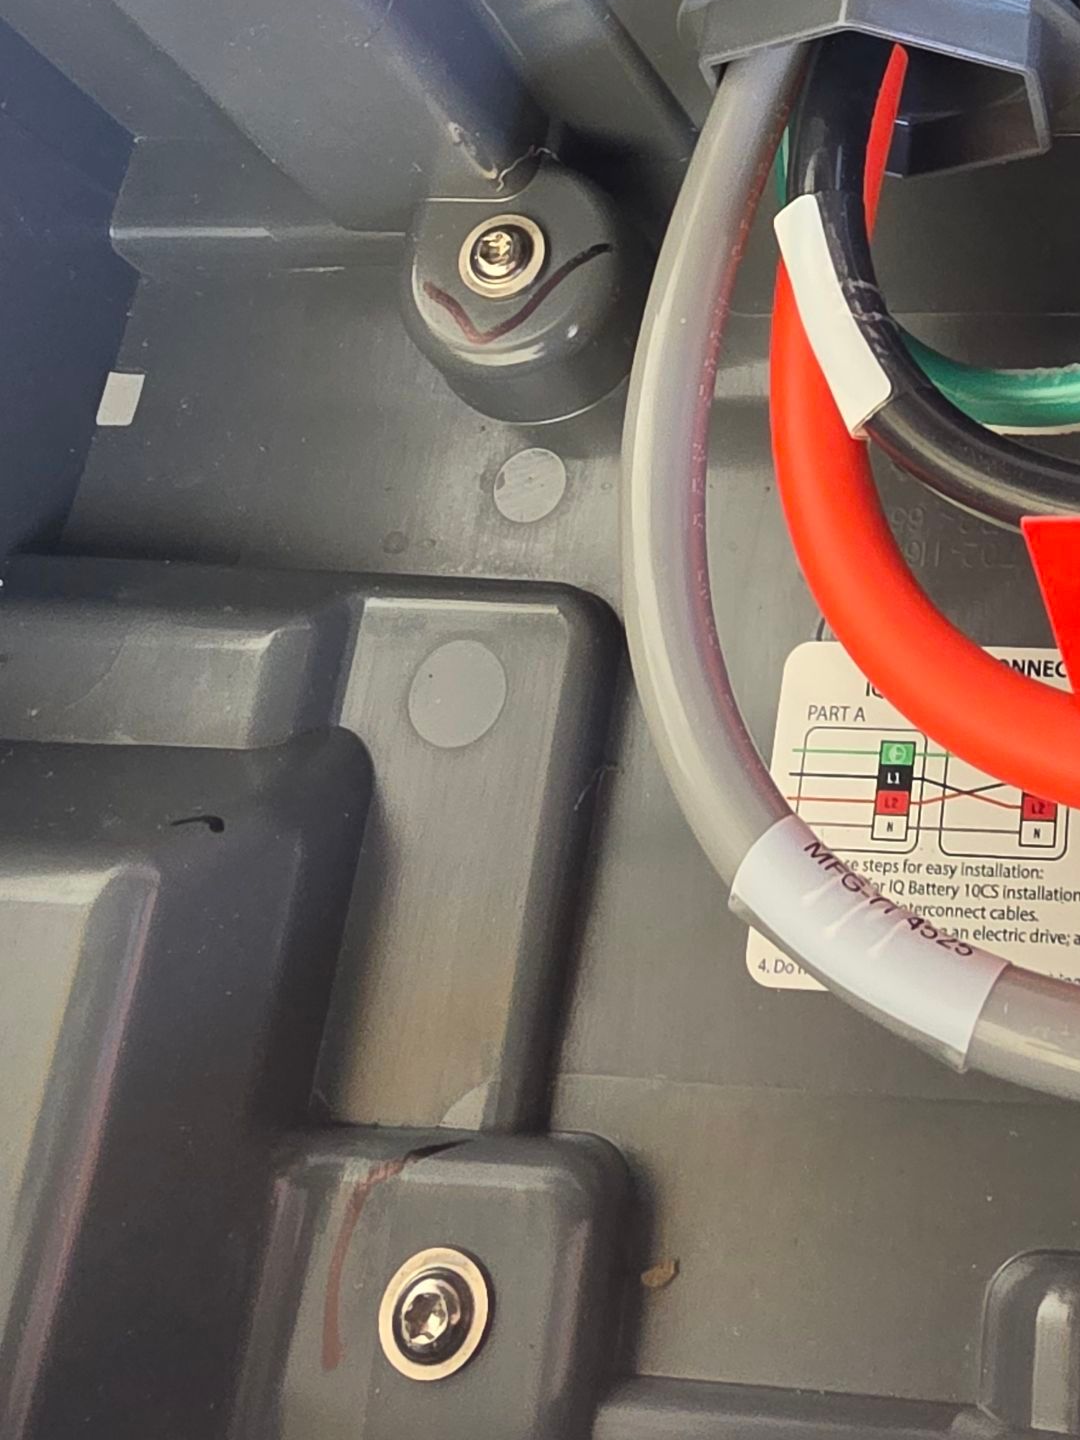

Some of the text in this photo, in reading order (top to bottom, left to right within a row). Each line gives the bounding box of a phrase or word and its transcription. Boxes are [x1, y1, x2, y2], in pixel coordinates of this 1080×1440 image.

[807, 705, 866, 722] PART A
[887, 772, 900, 785] L1
[884, 798, 898, 809] L2
[886, 822, 893, 833] N
[1034, 828, 1040, 839] N
[862, 859, 900, 876] steps
[903, 859, 922, 874] for
[925, 863, 957, 879] easy
[961, 862, 1044, 879] installation:
[889, 879, 904, 896] IQ
[909, 880, 960, 900] Battery
[965, 884, 999, 900] 10CS
[990, 906, 1039, 922] cables.
[951, 928, 969, 940] an
[977, 926, 1026, 944] electric
[1030, 930, 1070, 946] drive;
[758, 958, 770, 973] 4.
[774, 959, 795, 974] Do
